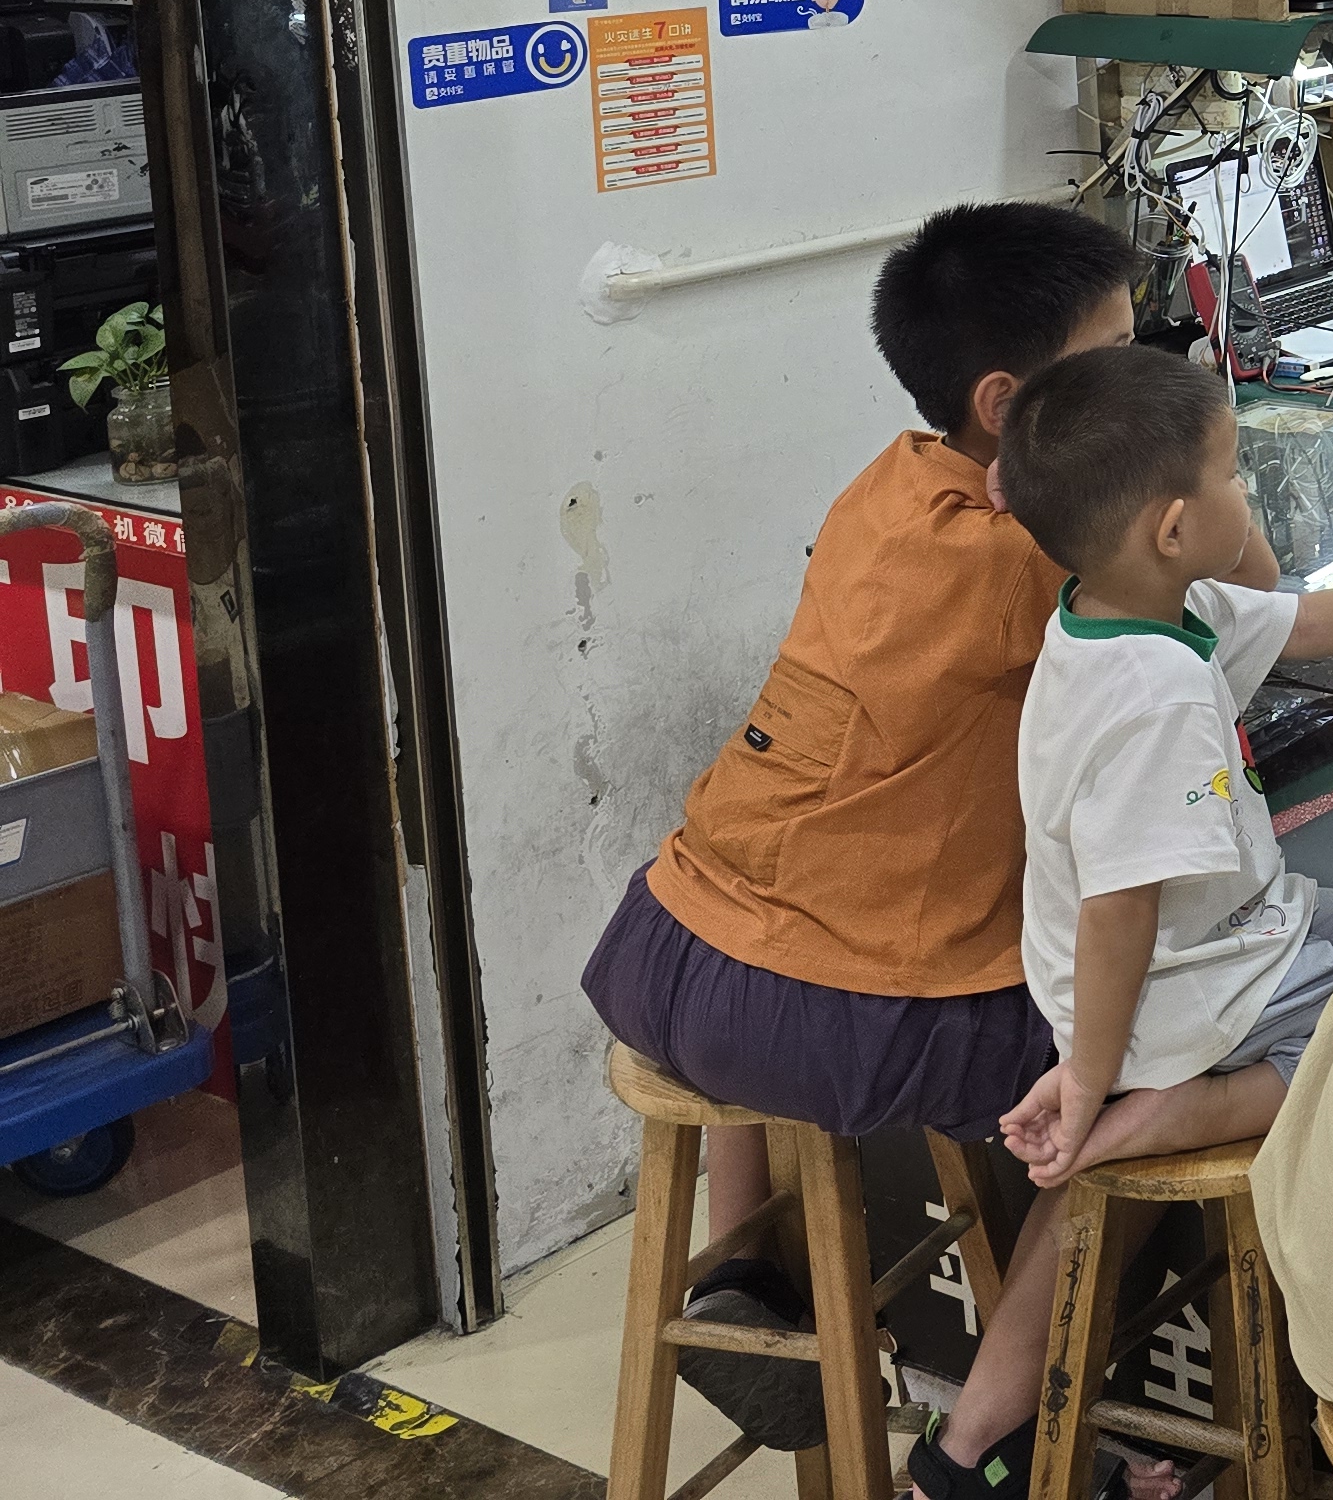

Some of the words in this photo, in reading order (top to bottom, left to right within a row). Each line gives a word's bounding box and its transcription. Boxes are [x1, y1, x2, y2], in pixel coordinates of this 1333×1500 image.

[742, 13, 763, 23] 支付宝
[604, 21, 692, 43] 火灾逃生7口诀
[422, 35, 514, 69] 贵重物品
[424, 59, 515, 85] 请妥善保管
[438, 85, 464, 98] 支付宝
[96, 512, 186, 553] 机微信
